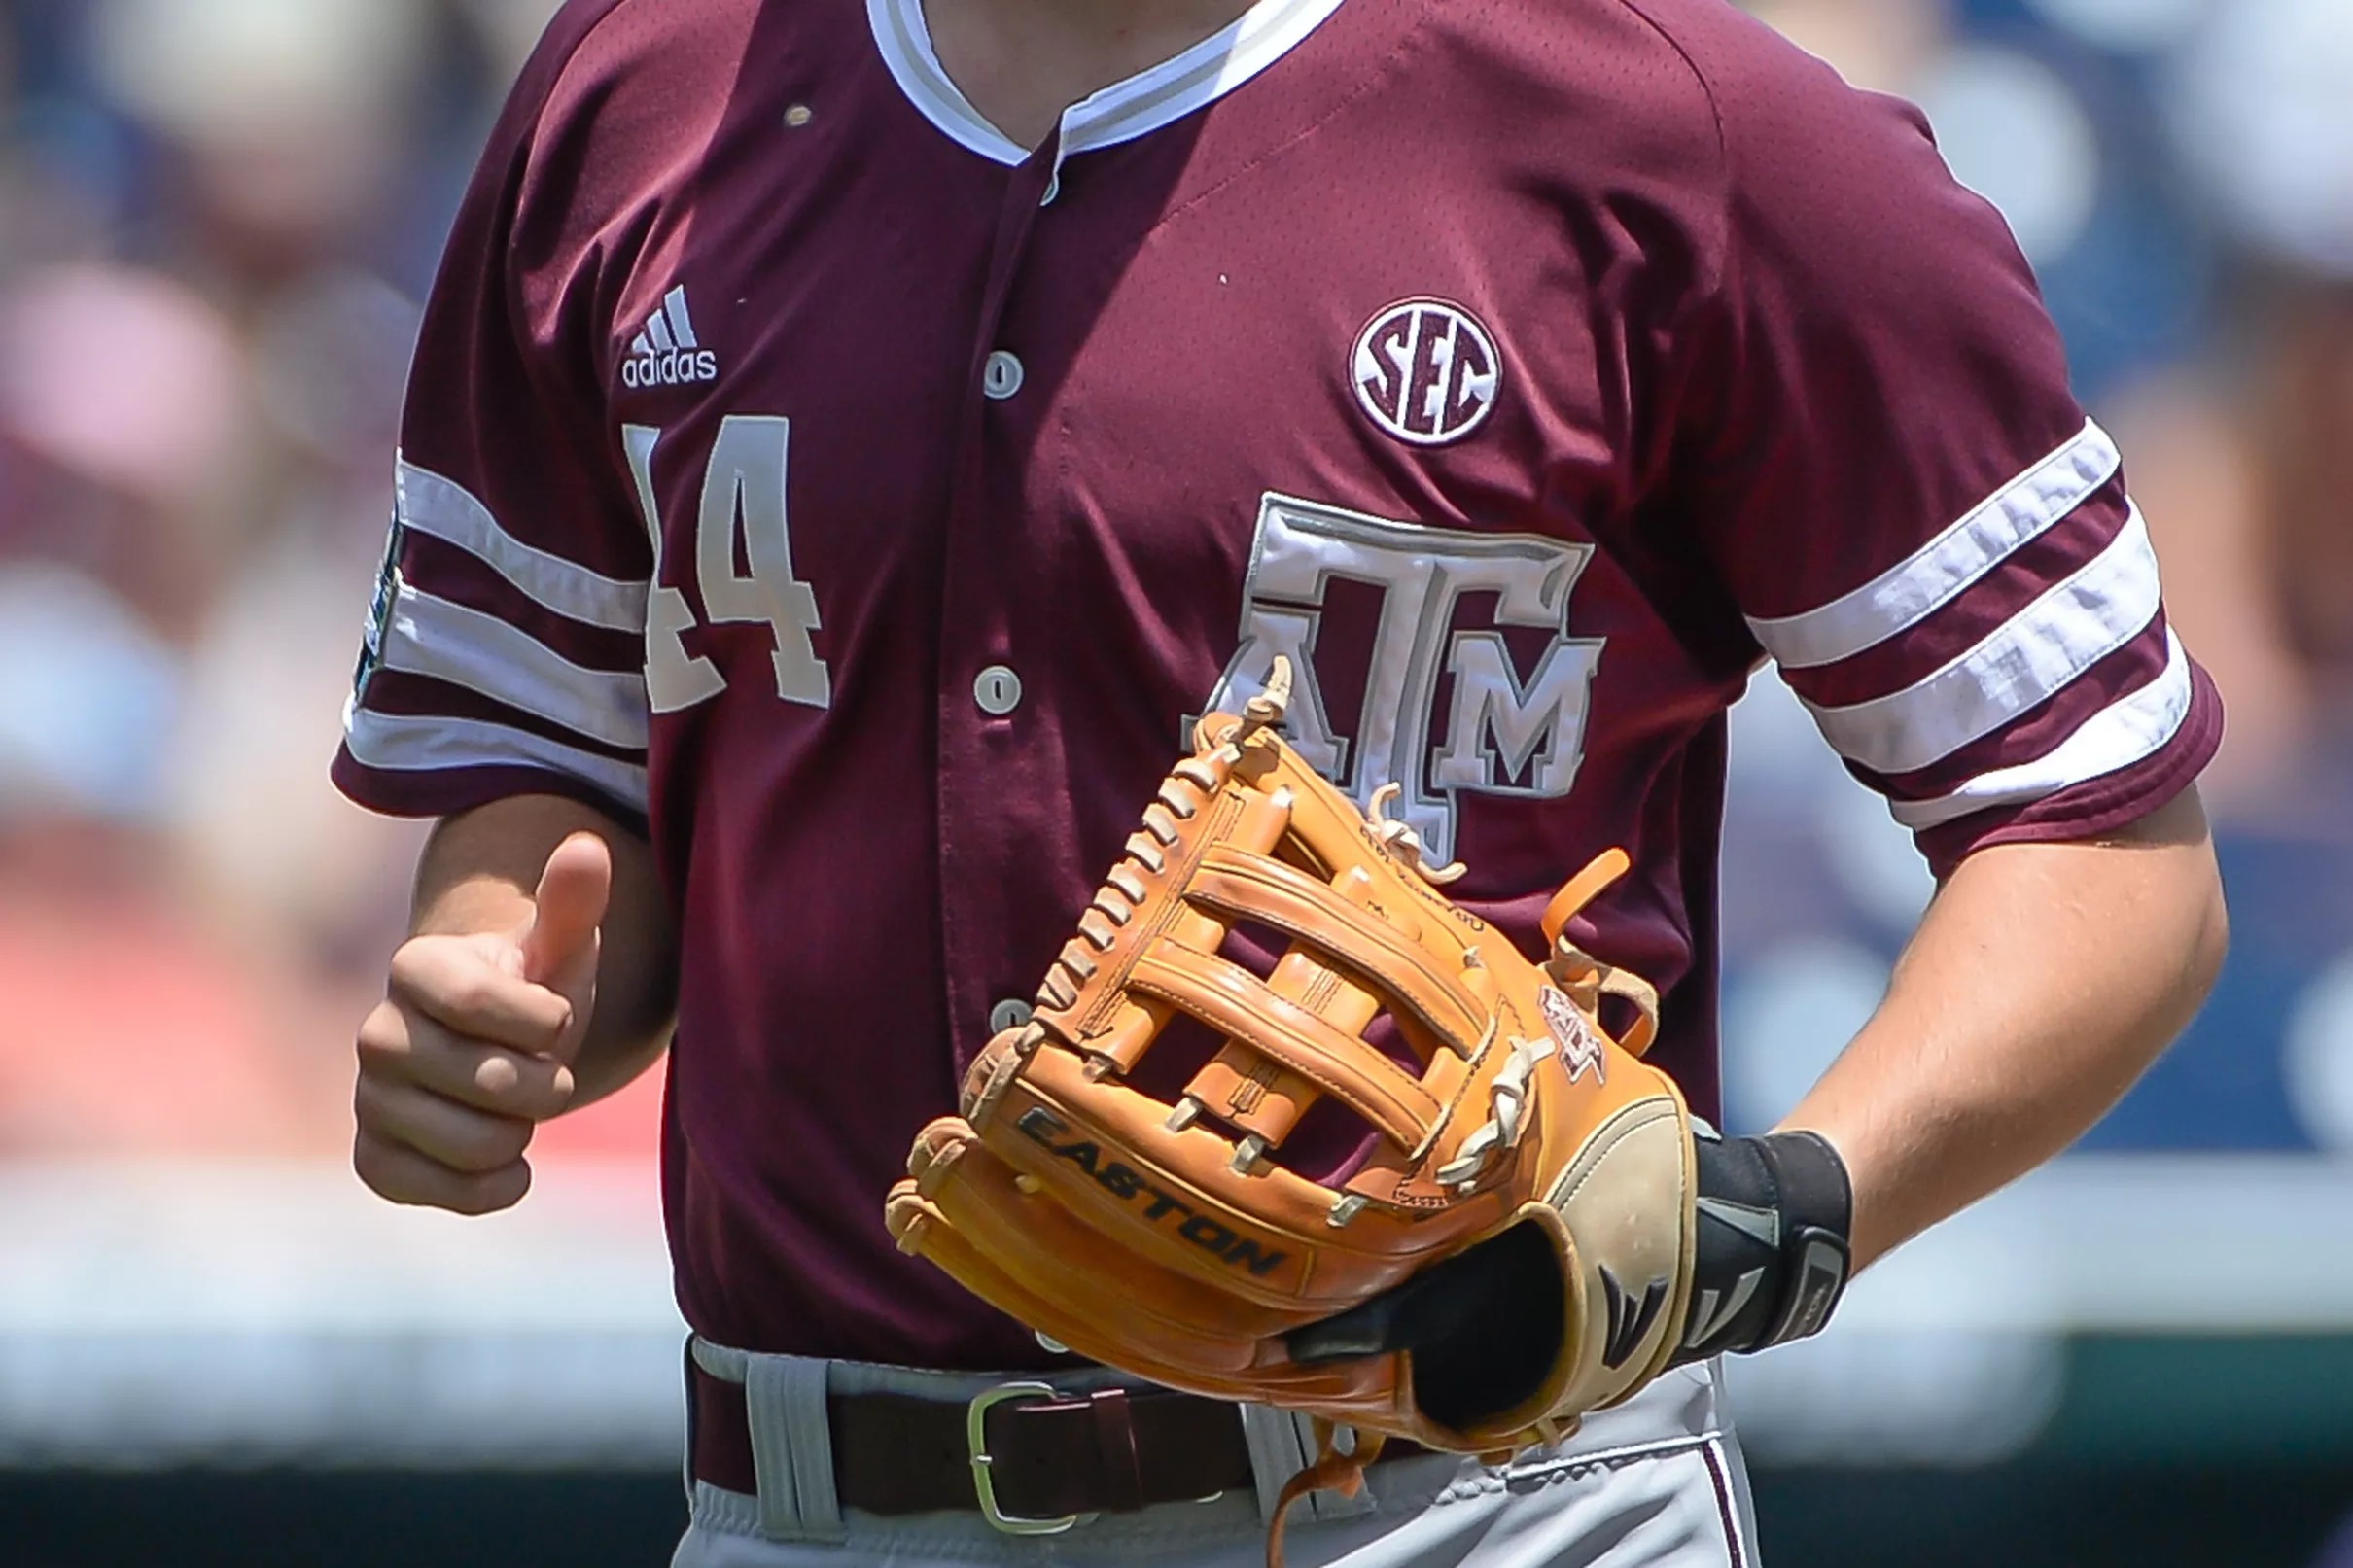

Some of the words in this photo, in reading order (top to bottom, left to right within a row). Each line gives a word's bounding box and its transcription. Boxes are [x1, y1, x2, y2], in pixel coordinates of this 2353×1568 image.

[622, 347, 717, 388] adidas
[1361, 309, 1492, 436] SEC
[1017, 1106, 1285, 1275] EASTON
